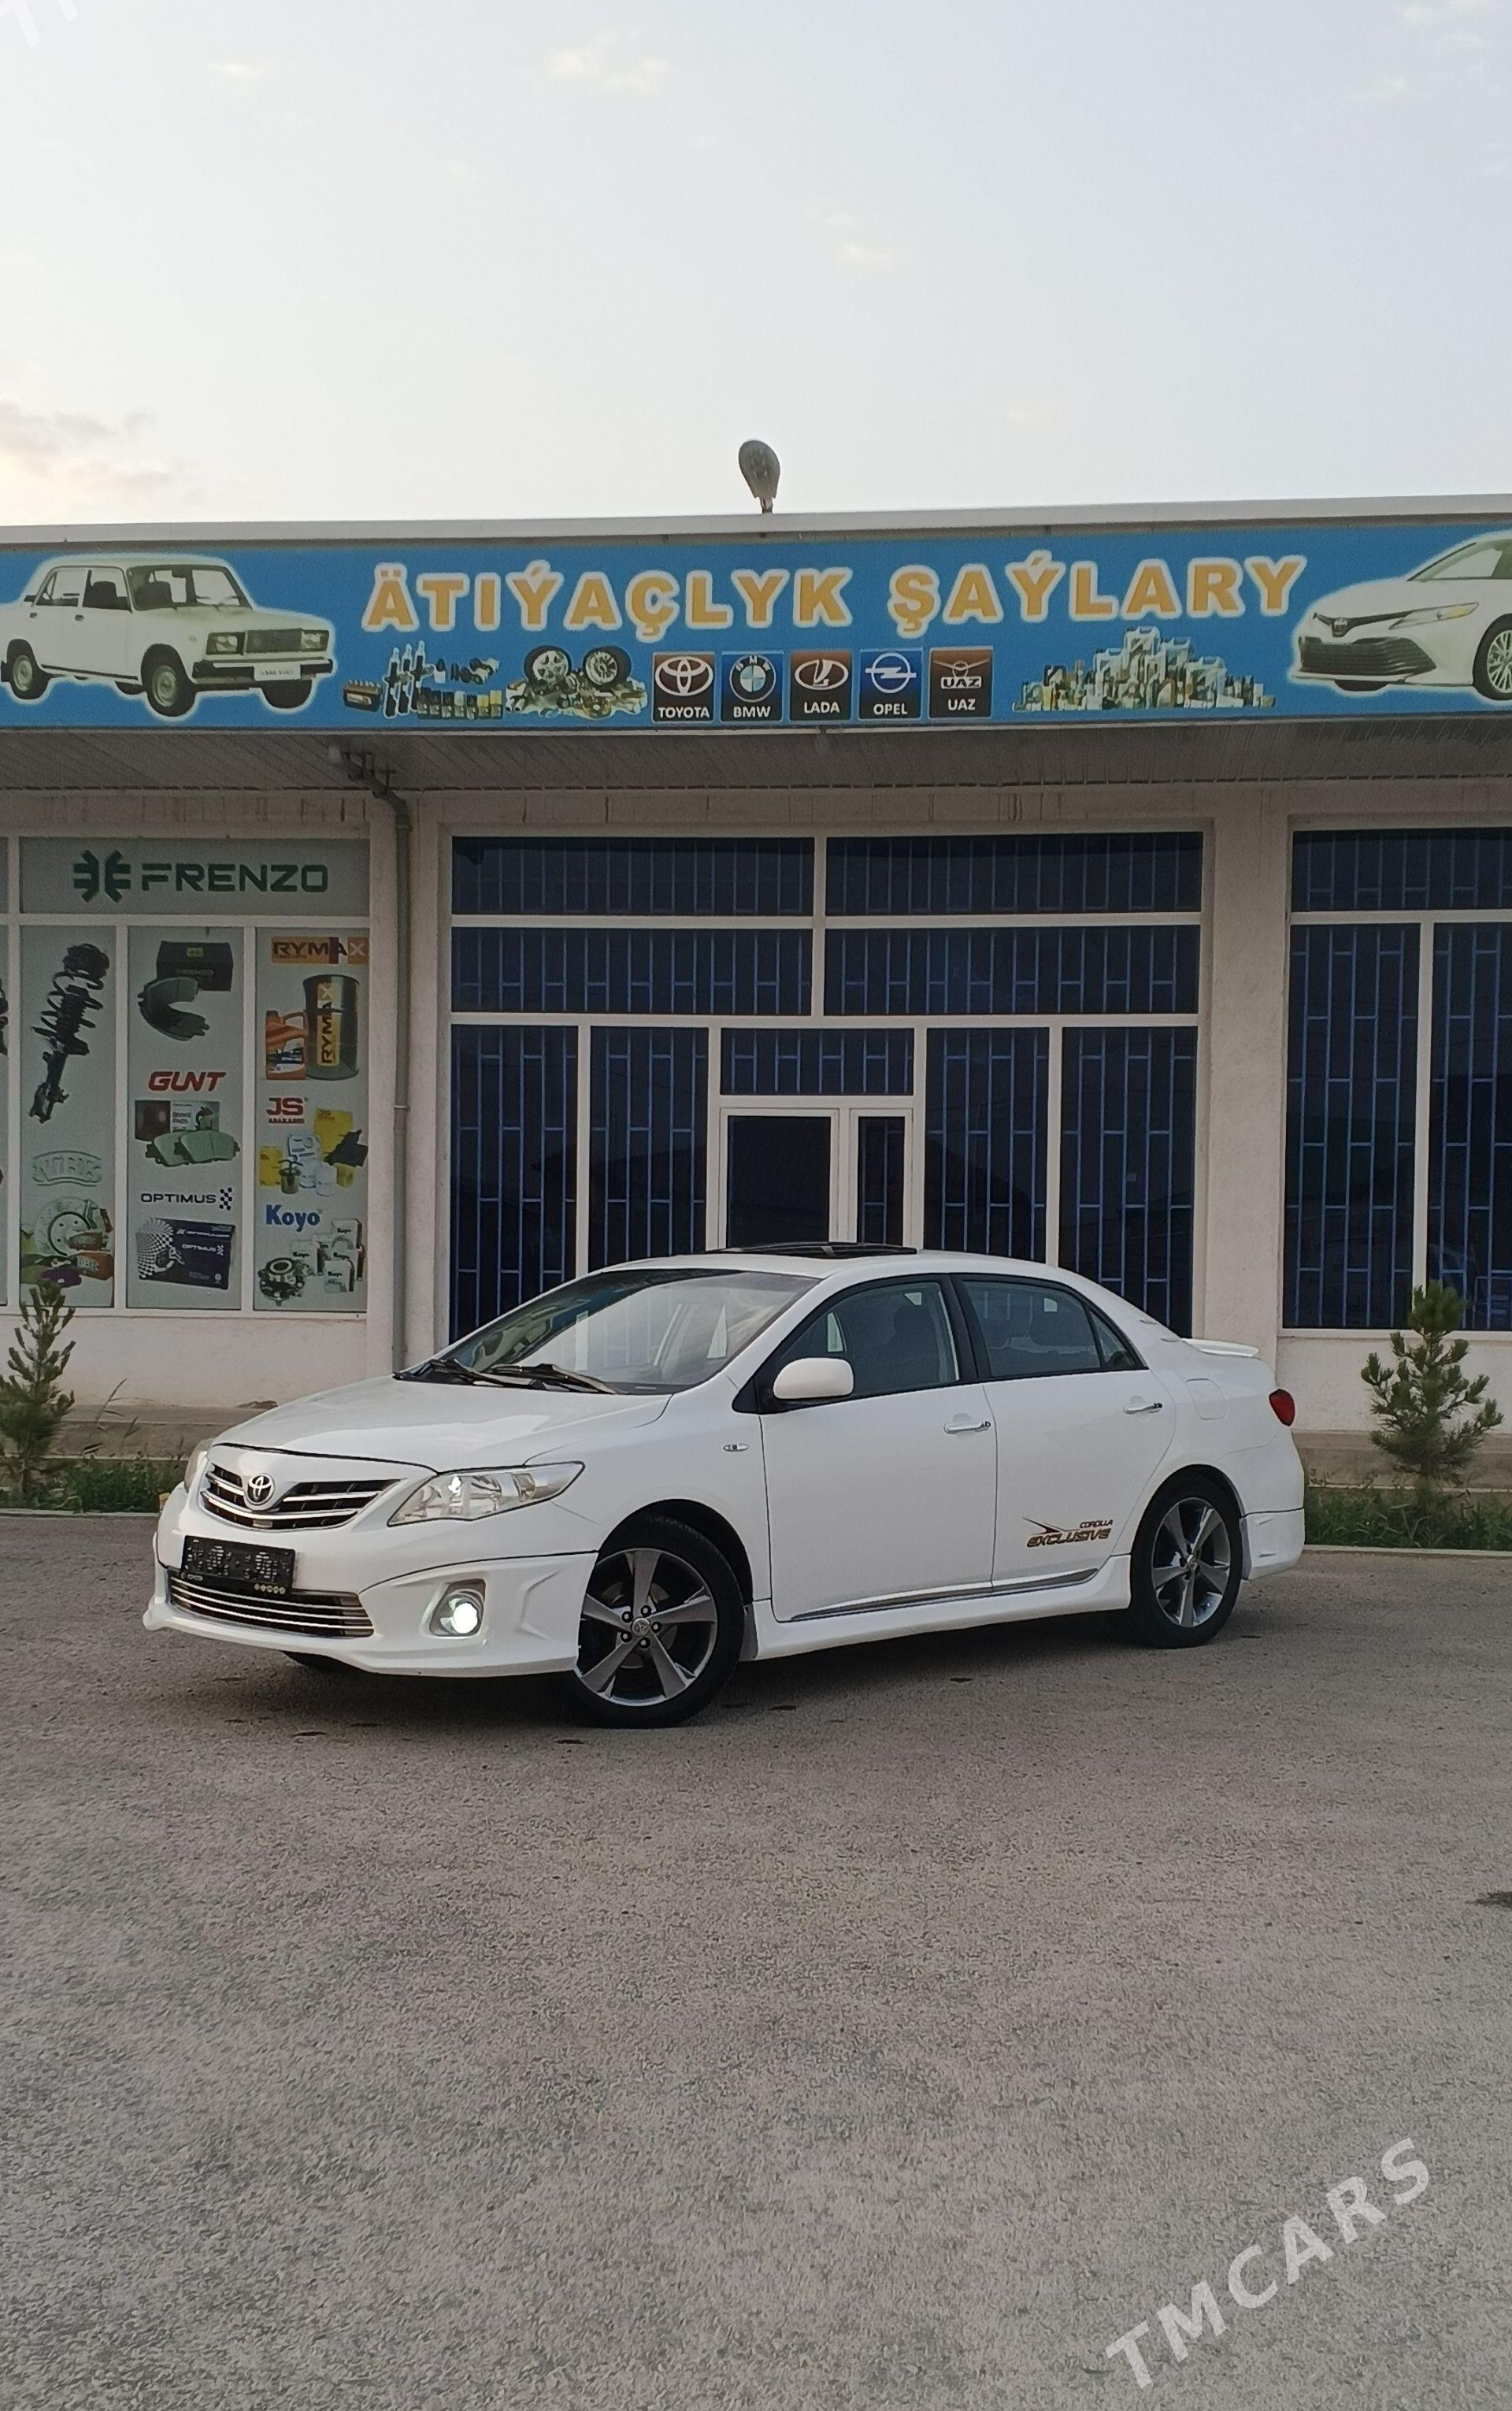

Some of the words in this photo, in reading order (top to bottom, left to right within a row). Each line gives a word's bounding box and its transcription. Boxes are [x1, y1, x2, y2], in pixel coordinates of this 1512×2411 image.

[363, 561, 851, 641] ÄTIÝAÇLYK
[888, 551, 1306, 636] ŞAÝLARY
[732, 705, 771, 718] BMW
[803, 701, 840, 714] LADA
[873, 703, 908, 716] OPEL
[947, 699, 976, 711] UAZ
[658, 707, 710, 719] TOYOTA
[141, 864, 328, 892] FRENZO
[272, 940, 367, 956] RYMAX
[266, 1097, 304, 1116] JS
[140, 1193, 217, 1204] OPTIMUS
[265, 1204, 321, 1232] Koyo
[1080, 1519, 1113, 1529] COROLLA
[1026, 1528, 1112, 1547] EXCLUSIVE
